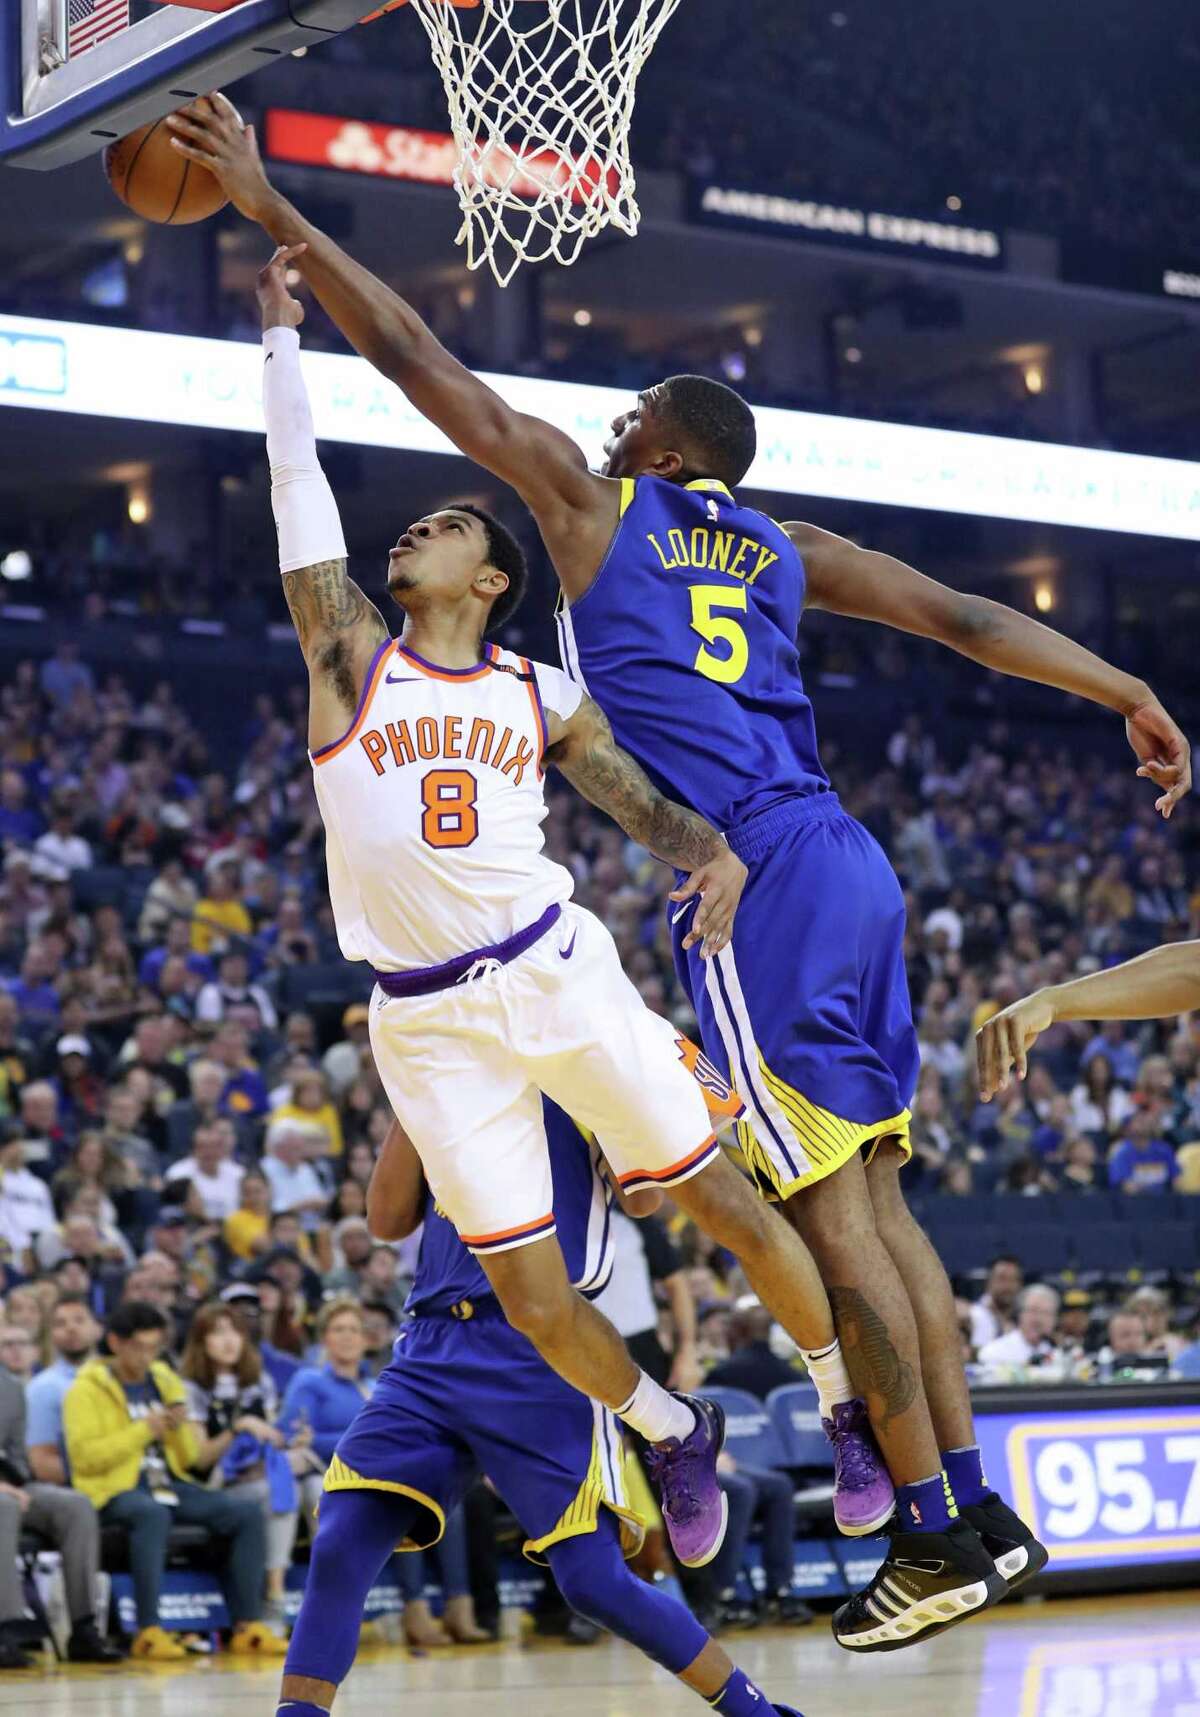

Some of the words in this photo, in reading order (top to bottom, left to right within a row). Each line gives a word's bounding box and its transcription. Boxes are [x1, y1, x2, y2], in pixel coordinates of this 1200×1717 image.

[702, 186, 865, 236] AMERICAN
[867, 212, 999, 258] EXPRESS
[647, 528, 779, 586] LOONEY
[688, 583, 749, 684] 5
[360, 715, 535, 788] PHOENIX
[421, 768, 479, 850] 8
[1035, 1435, 1200, 1539] 95.7
